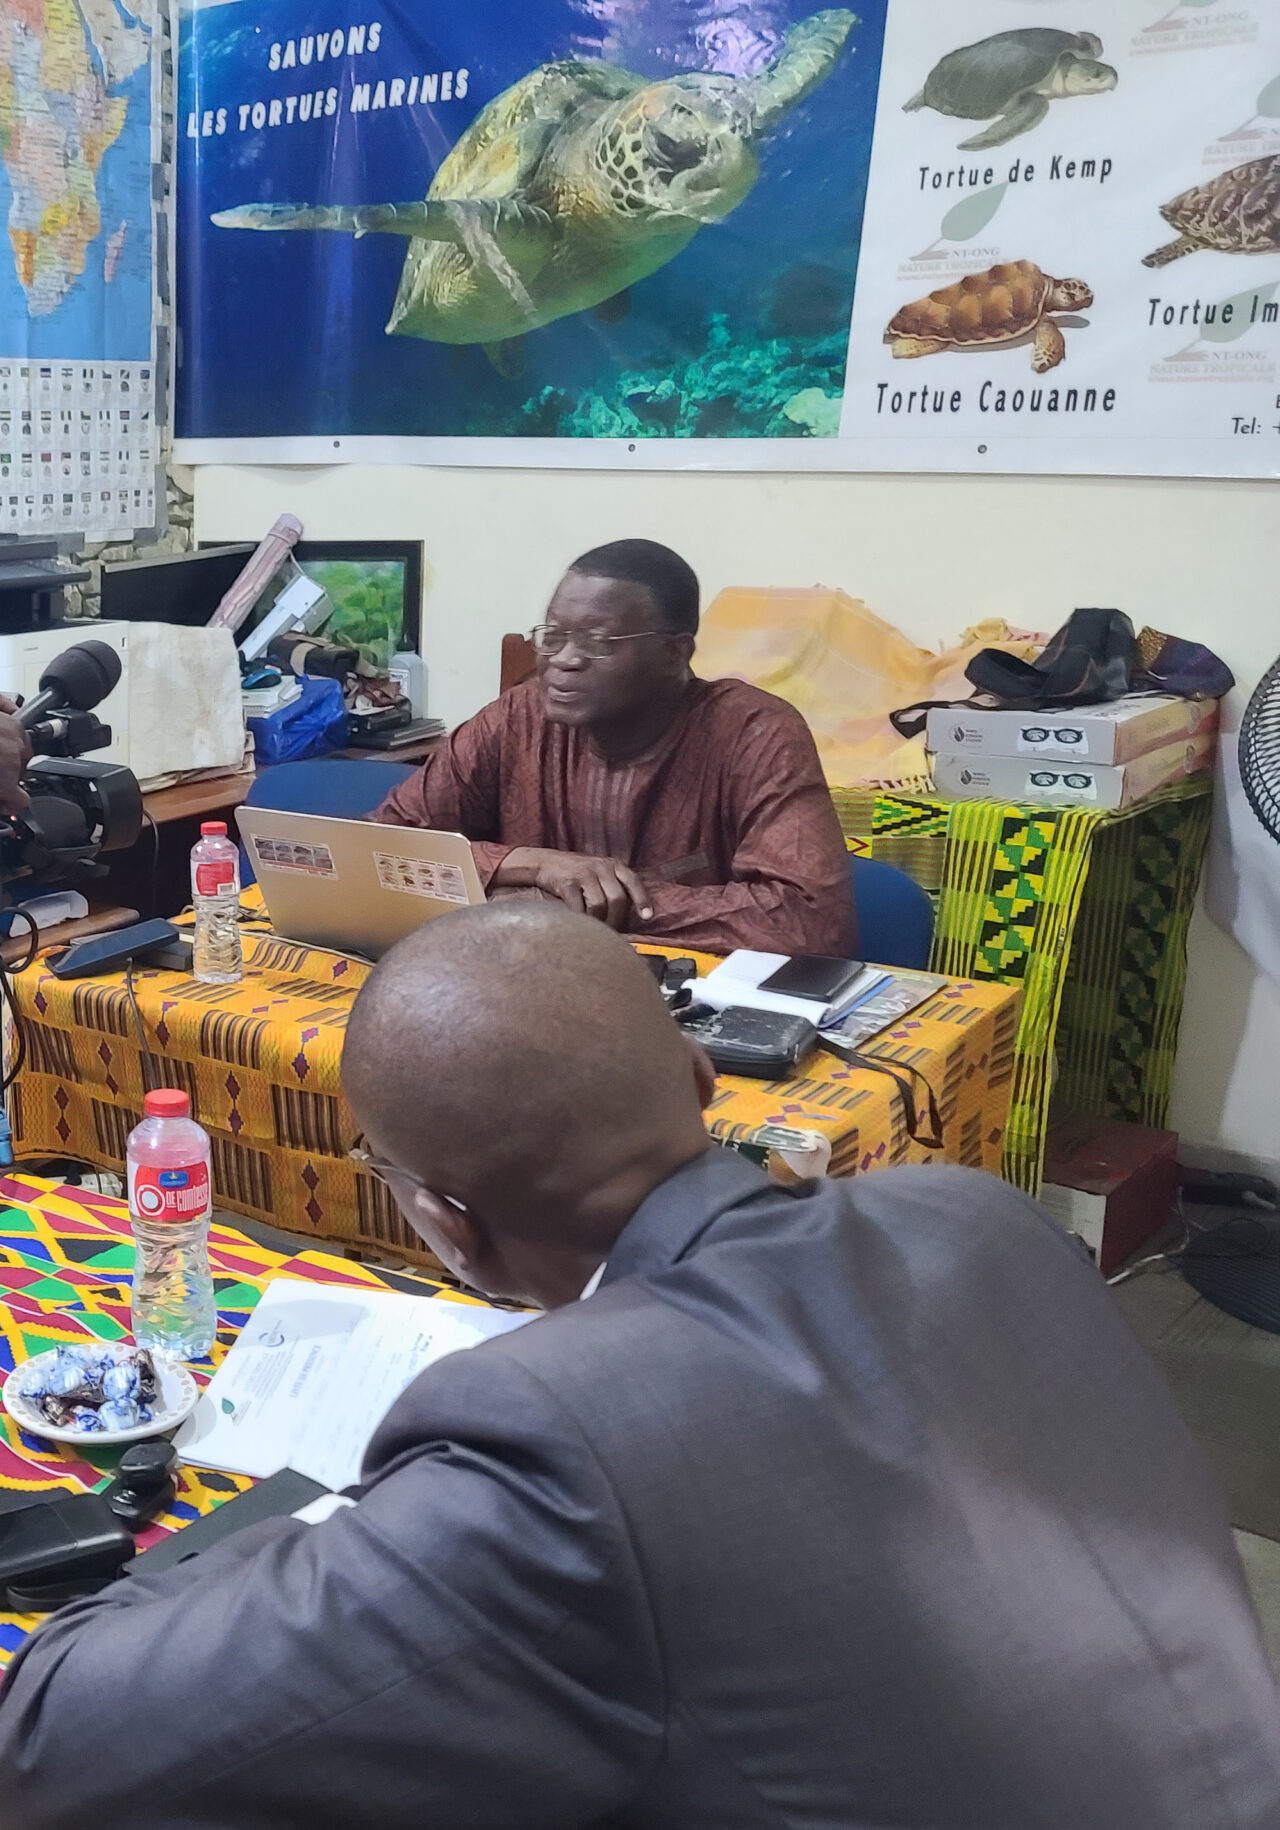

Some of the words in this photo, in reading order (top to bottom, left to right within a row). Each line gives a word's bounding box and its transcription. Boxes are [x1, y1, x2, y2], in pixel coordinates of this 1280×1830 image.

[268, 21, 382, 71] SAUVONS
[186, 107, 228, 139] LES
[238, 87, 338, 131] TORTUES
[350, 68, 469, 113] MARINES
[919, 165, 994, 190] Tortue
[1008, 157, 1035, 183] de
[1049, 154, 1113, 184] Kemp
[952, 247, 1000, 259] NT-ONG
[1148, 298, 1234, 325] Tortue
[876, 383, 962, 413] Tortue
[979, 380, 1117, 412] Caouanne
[1231, 416, 1262, 435] Tel:
